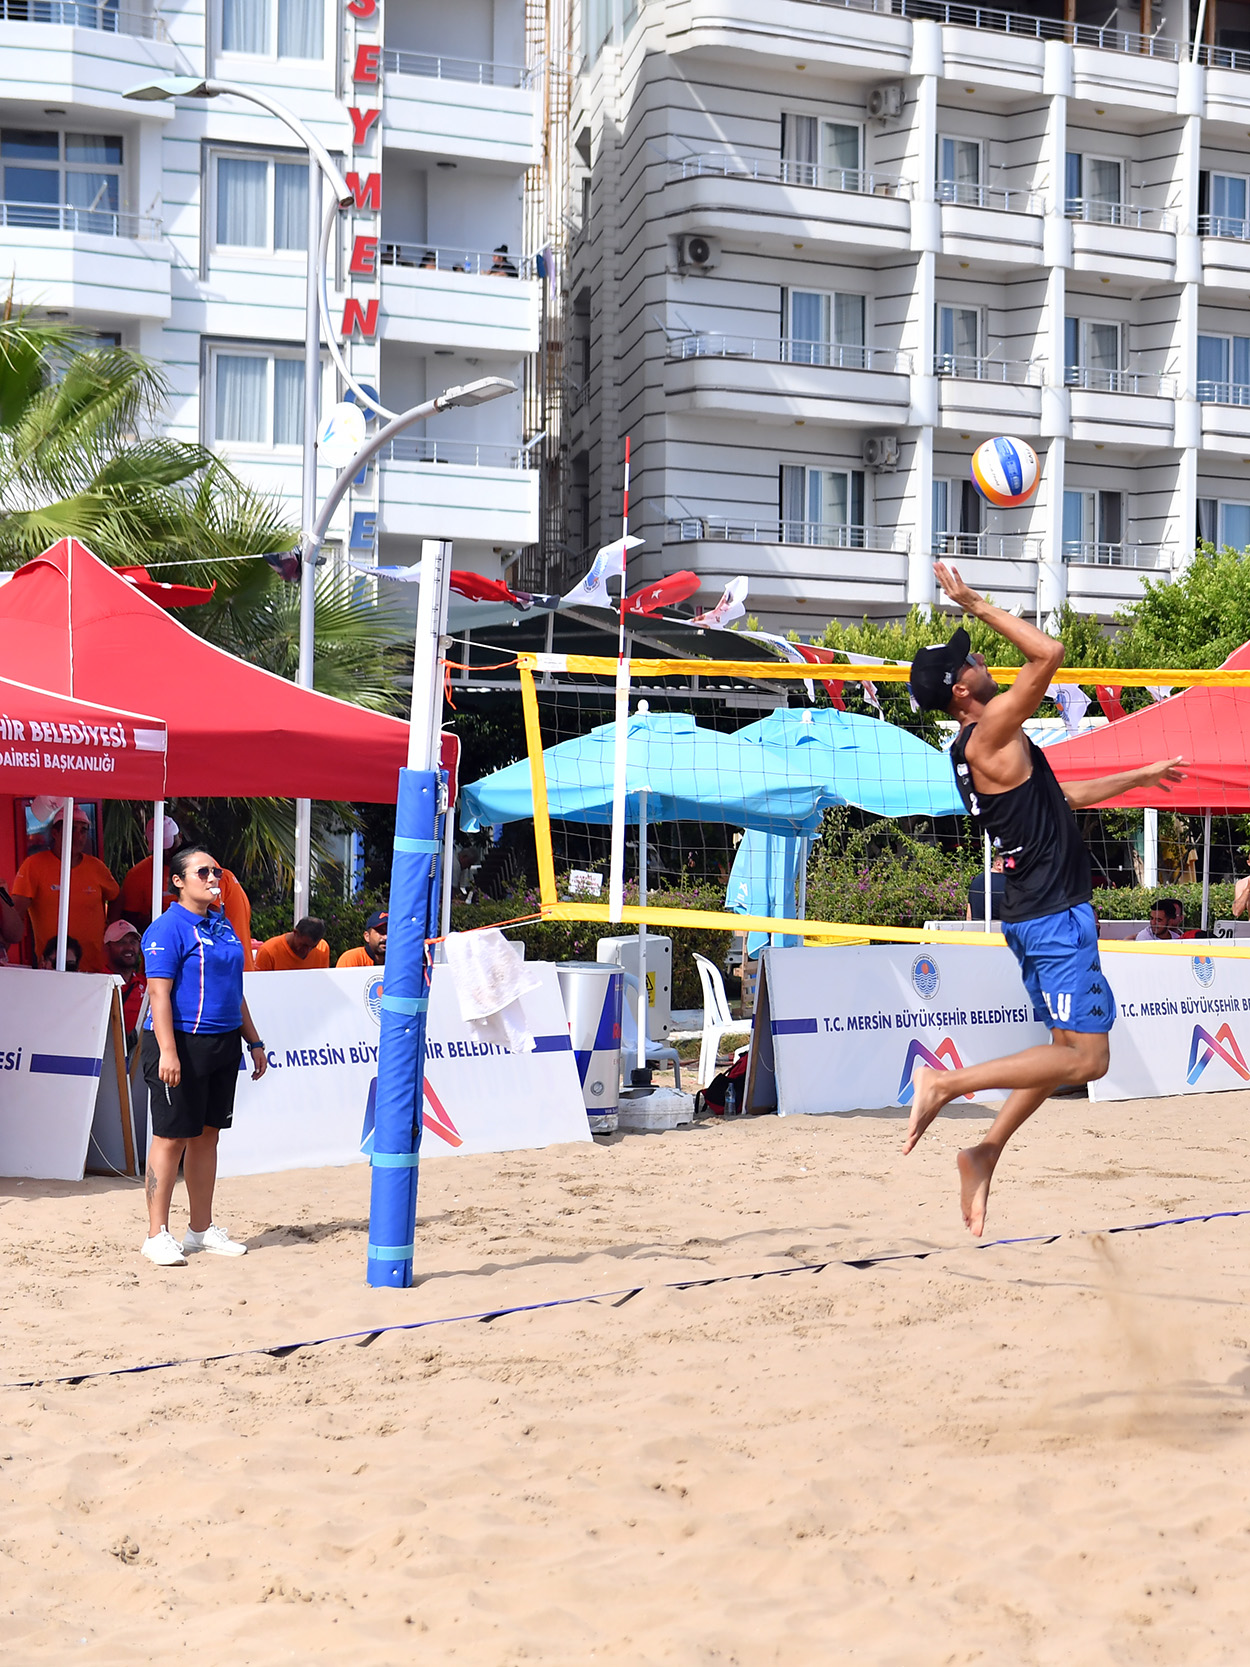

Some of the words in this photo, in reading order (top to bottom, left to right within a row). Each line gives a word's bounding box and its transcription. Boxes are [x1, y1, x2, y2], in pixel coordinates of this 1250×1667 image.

[28, 719, 127, 748] BELEDİYESİ
[44, 753, 115, 773] BAŞKANLIĞI
[823, 1016, 844, 1032] T.C.
[847, 1010, 892, 1031] MERSİN
[896, 1008, 967, 1031] BÜYÜKŞEHİR
[970, 1004, 1029, 1026] BELEDİYESİ
[1120, 1003, 1139, 1018] T.C.
[1140, 997, 1178, 1017] MERSİN
[1181, 994, 1240, 1017] BÜYÜKŞEHİR
[286, 1042, 346, 1067] MERSİN
